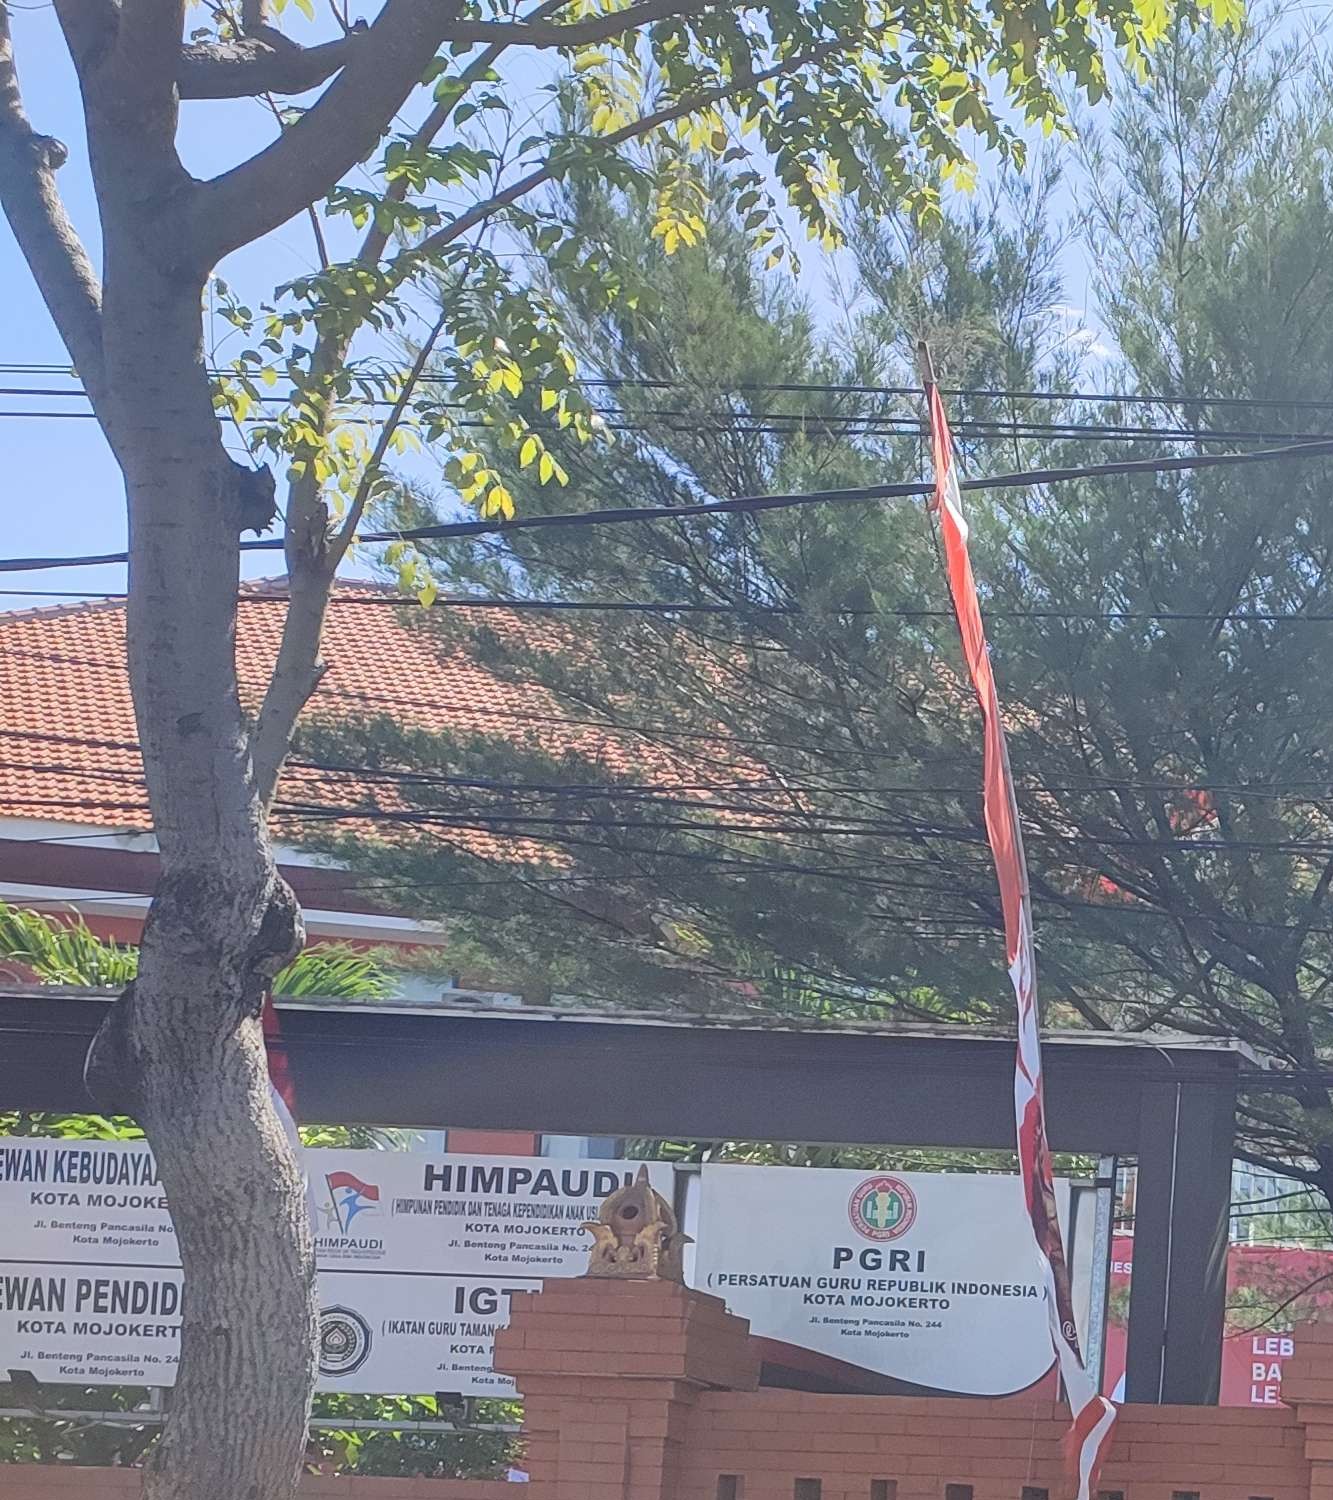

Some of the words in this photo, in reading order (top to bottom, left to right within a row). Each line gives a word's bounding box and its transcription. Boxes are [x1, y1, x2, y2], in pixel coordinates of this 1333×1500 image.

[53, 1150, 158, 1187] KEBUDAYA
[30, 1191, 81, 1207] KOTA
[396, 1198, 433, 1215] HIMPUNAN
[434, 1199, 466, 1217] PENDIDIK
[467, 1200, 482, 1217] DAN
[484, 1201, 512, 1218] TENAGA
[513, 1202, 564, 1220] KEPENDIDIKAN
[566, 1204, 585, 1221] ANAK
[51, 1220, 96, 1232] Benteng
[100, 1222, 155, 1233] Pancasila
[464, 1222, 500, 1235] KOTA
[504, 1224, 587, 1237] MOJOKERTO
[73, 1234, 99, 1244] Kota
[103, 1236, 159, 1247] Mojokerto
[314, 1237, 383, 1249] HIMPAUDI
[464, 1239, 506, 1251] Benteng
[510, 1241, 559, 1252] Pancasila
[484, 1252, 509, 1263] Kota
[512, 1254, 563, 1266] Mojokerto
[833, 1247, 925, 1273] PGRI
[718, 1273, 811, 1289] PERSATUAN
[816, 1276, 862, 1291] GURU
[867, 1278, 946, 1294] REPUBLIK
[951, 1281, 1038, 1299] INDONESIA
[0, 1276, 66, 1313] WAN
[803, 1293, 846, 1306] KOTA
[850, 1294, 950, 1310] MOJOKERTO
[17, 1320, 67, 1335] KOTA
[388, 1320, 425, 1335] IKATAN
[429, 1321, 457, 1336] GURU
[460, 1322, 494, 1338] TAMAN
[823, 1316, 860, 1327] Benteng
[862, 1318, 906, 1328] Pancasila
[908, 1319, 922, 1328] No.
[925, 1320, 943, 1329] 244
[840, 1328, 863, 1337] Kota
[865, 1329, 910, 1340] Mojokerto
[450, 1344, 485, 1355] KOTA
[38, 1351, 83, 1363] Benteng
[86, 1352, 140, 1363] Pancasila
[143, 1354, 162, 1364] No.
[59, 1365, 85, 1375] Kota
[88, 1366, 145, 1378] Mojokerto
[451, 1363, 493, 1374] Benteng
[471, 1376, 495, 1385] Kota
